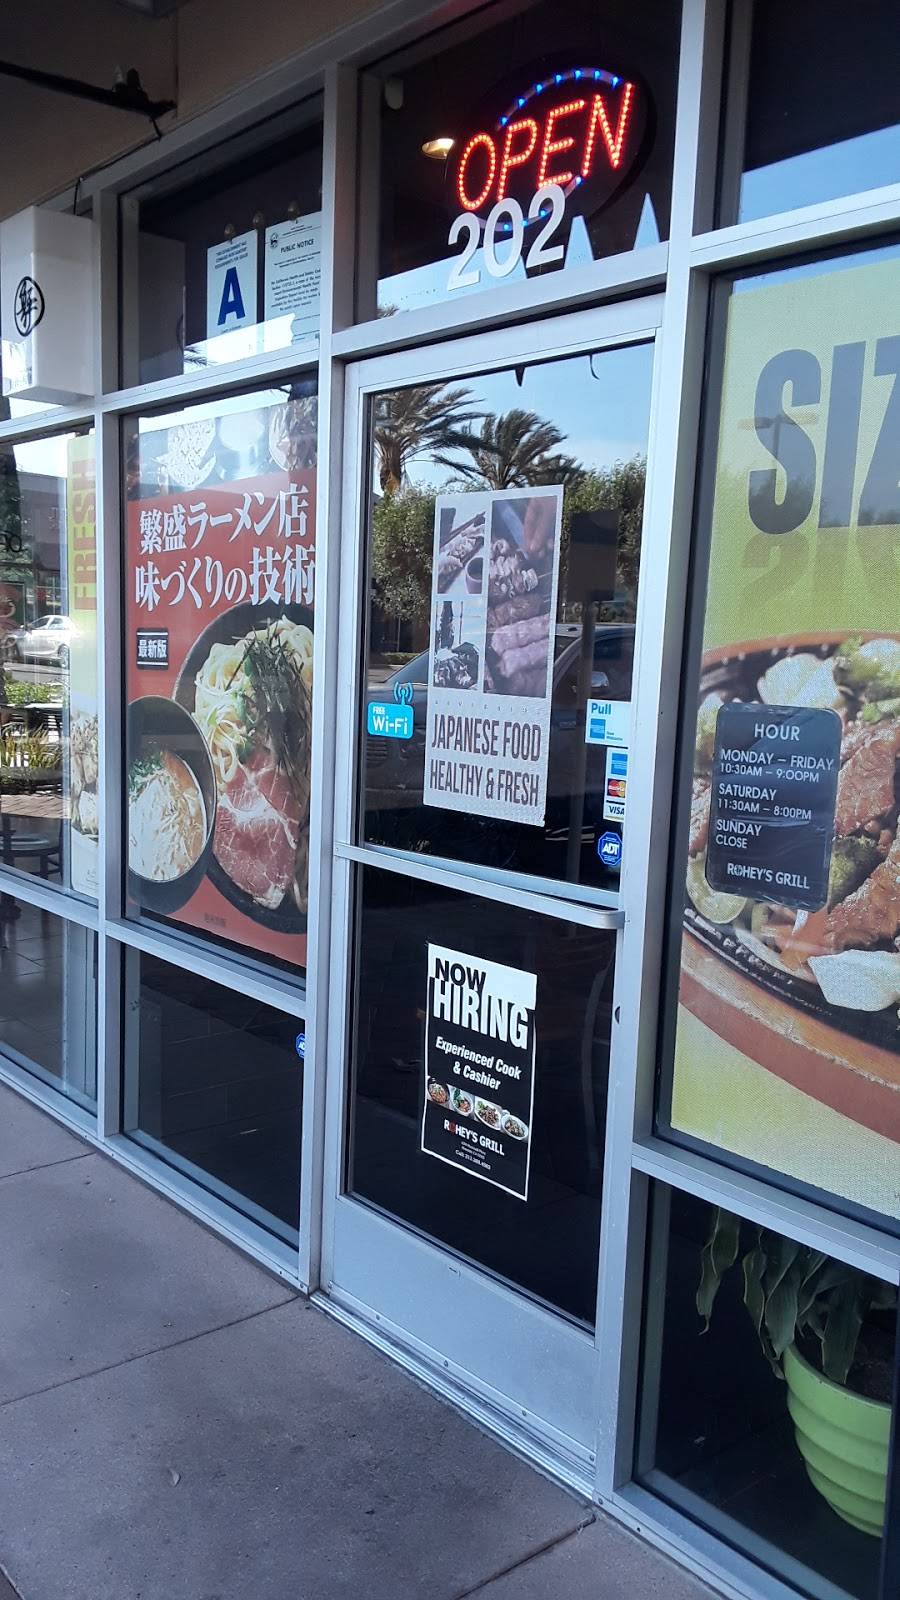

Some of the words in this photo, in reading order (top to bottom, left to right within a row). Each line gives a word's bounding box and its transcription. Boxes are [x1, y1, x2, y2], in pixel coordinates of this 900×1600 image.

[458, 82, 635, 211] OPEN
[280, 243, 296, 254] PUBLIC
[297, 238, 315, 249] NOTICE
[448, 184, 566, 291] 202
[217, 266, 246, 326] A
[139, 482, 309, 555] 繁盛ラーメン店
[72, 460, 97, 610] FRESH
[135, 544, 316, 612] 味づくりの技術
[137, 639, 168, 659] 最新版
[591, 702, 612, 716] Pull
[373, 715, 408, 735] Wi-Fi
[754, 723, 800, 741] HOUR
[431, 714, 500, 757] JAPANESE
[503, 721, 542, 762] FOOD
[720, 748, 774, 765] MONDAY
[790, 755, 834, 771] FRIDAY
[720, 763, 762, 777] 10:30AM
[429, 759, 483, 797] HEALTHY
[485, 768, 495, 800] &
[497, 769, 540, 807] FRESH
[719, 783, 777, 801] SATURDAY
[608, 805, 625, 816] VISA
[718, 798, 760, 813] 11:30AM
[773, 805, 812, 819] 8:00PM
[716, 819, 762, 836] SUNDAY
[602, 842, 619, 855] ADT
[715, 834, 748, 849] CLOSE
[727, 862, 773, 882] ROHEY'S
[775, 871, 810, 890] GRILL
[435, 957, 487, 994] NOW
[433, 977, 528, 1050] HIRING
[435, 1035, 494, 1069] Experienced
[495, 1059, 522, 1080] Cook
[453, 1061, 461, 1075] &
[463, 1064, 501, 1090] Cashier
[479, 1135, 505, 1156] GRILL
